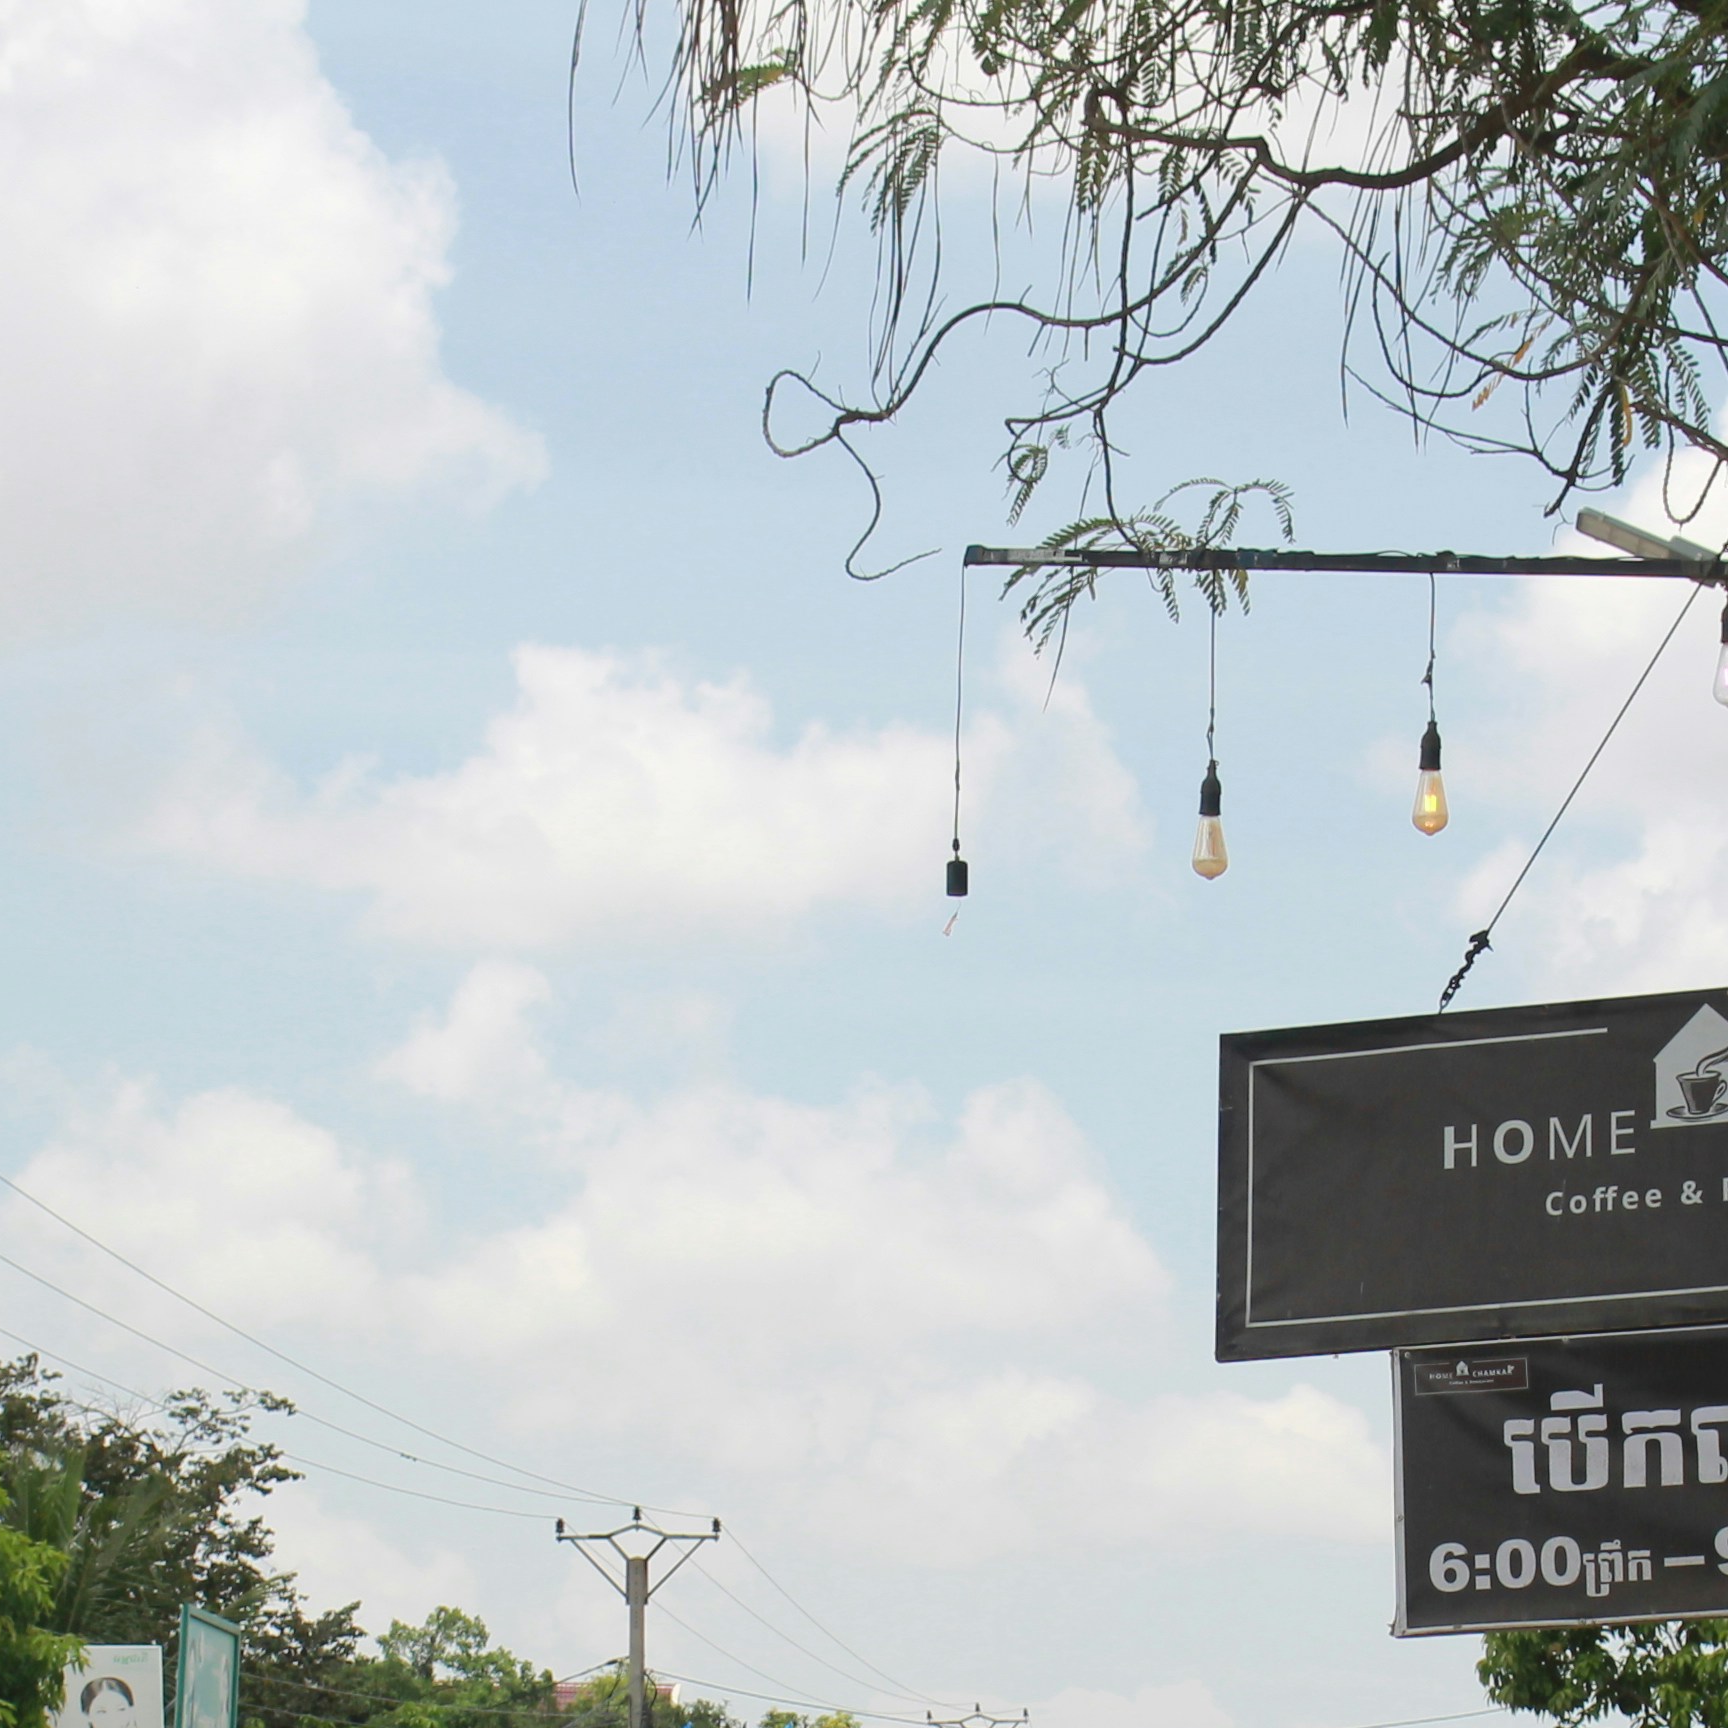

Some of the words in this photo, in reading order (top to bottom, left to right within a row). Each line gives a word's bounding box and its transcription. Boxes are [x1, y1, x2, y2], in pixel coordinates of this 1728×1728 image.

[1443, 1109, 1636, 1170] HOME
[1545, 1184, 1663, 1217] Coffee
[1680, 1178, 1704, 1205] &
